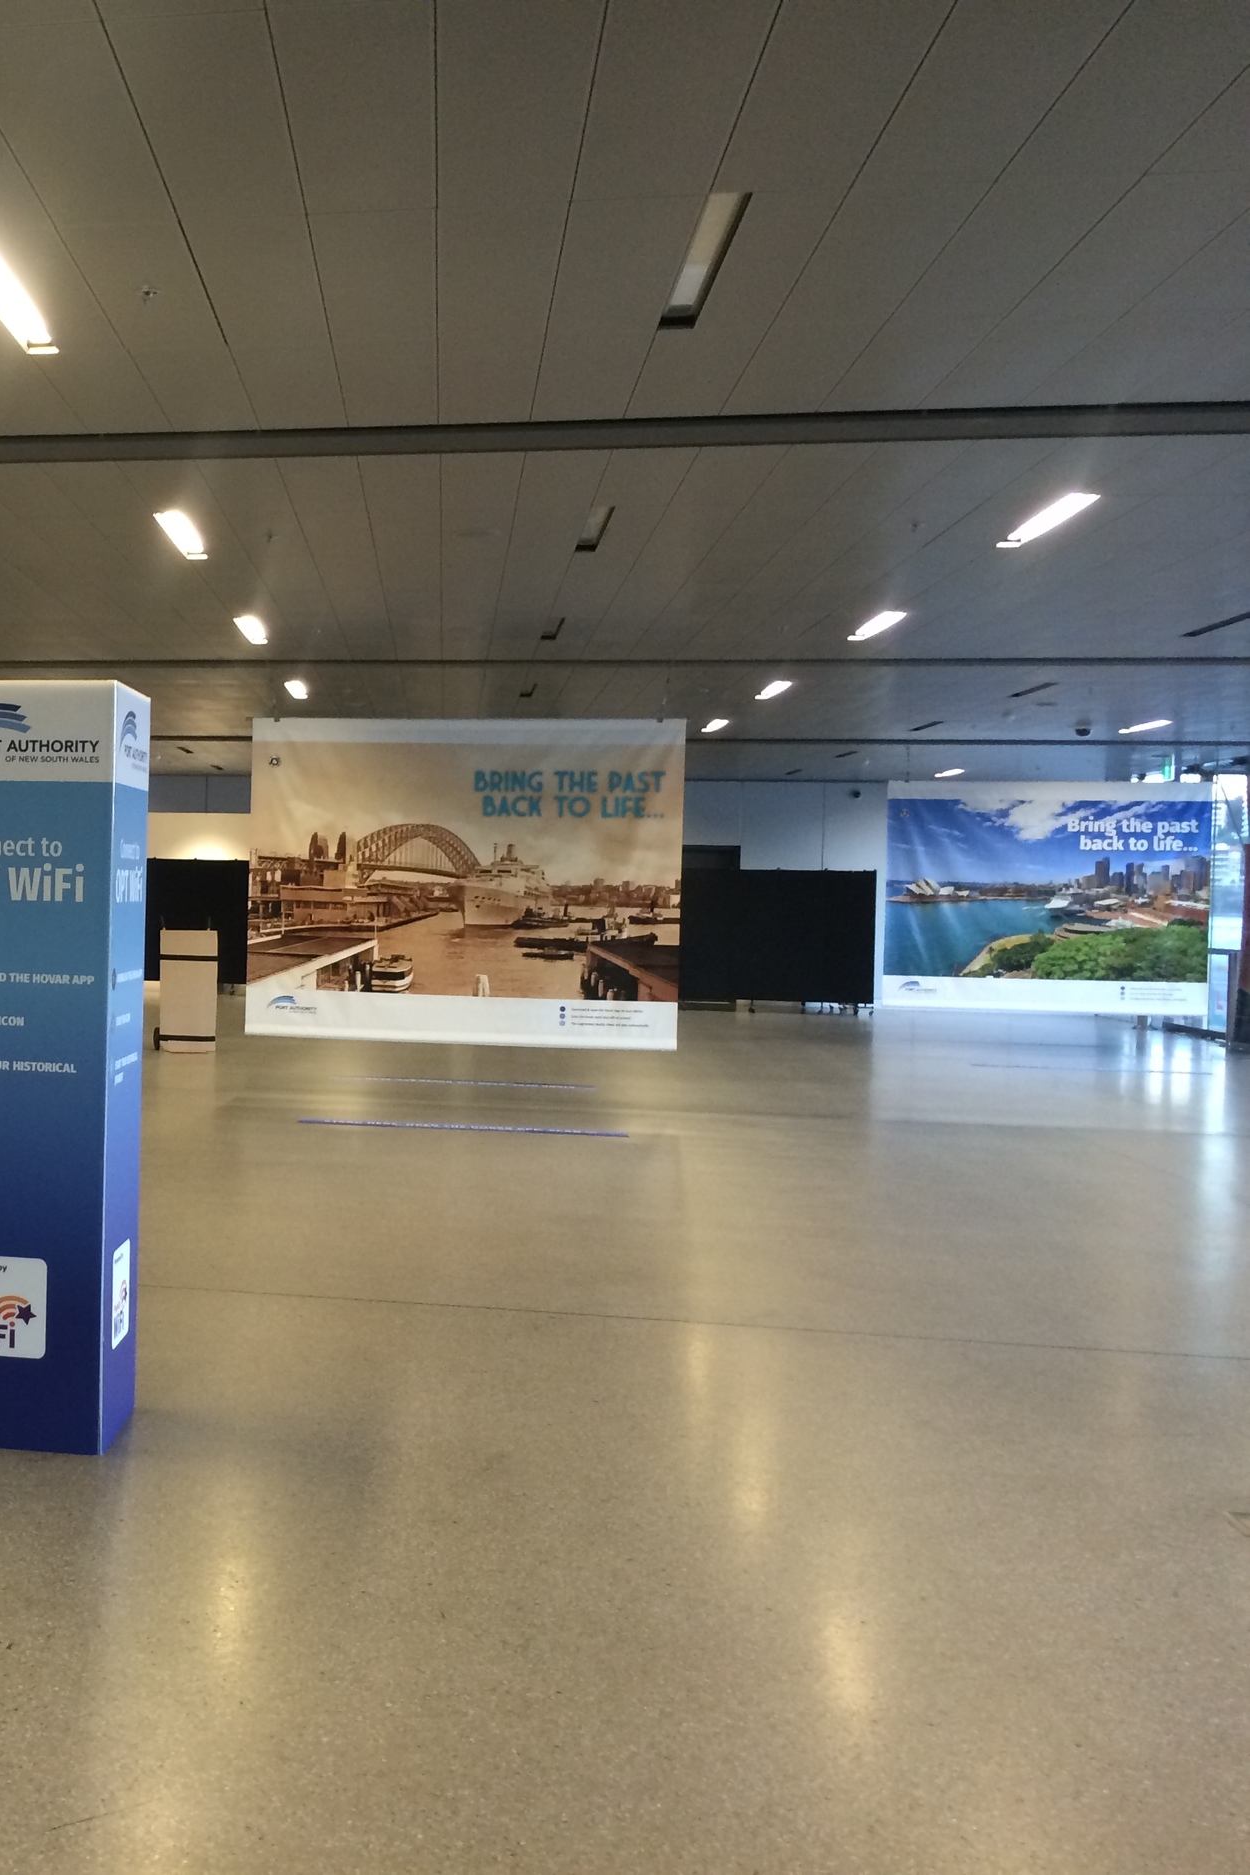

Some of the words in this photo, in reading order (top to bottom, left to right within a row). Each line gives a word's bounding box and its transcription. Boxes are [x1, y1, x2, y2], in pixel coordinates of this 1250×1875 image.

[6, 740, 100, 753] AUTHORITY
[474, 770, 543, 793] BRING
[554, 770, 598, 793] THE
[608, 770, 666, 793] PAST
[482, 795, 542, 817] BACK
[553, 795, 590, 818] TO
[601, 795, 665, 819] LIFE...
[1067, 816, 1117, 836] Bring
[1121, 817, 1153, 833] the
[1157, 819, 1199, 839] past
[41, 837, 63, 857] to
[1080, 835, 1124, 851] back
[1128, 837, 1148, 851] to
[1153, 835, 1198, 852] life...
[8, 862, 85, 902] WiFi
[116, 869, 129, 903] OPT
[9, 972, 30, 983] THE
[32, 973, 70, 984] HOVAR
[71, 975, 95, 985] APP
[13, 1061, 77, 1073] HISTORICAL
